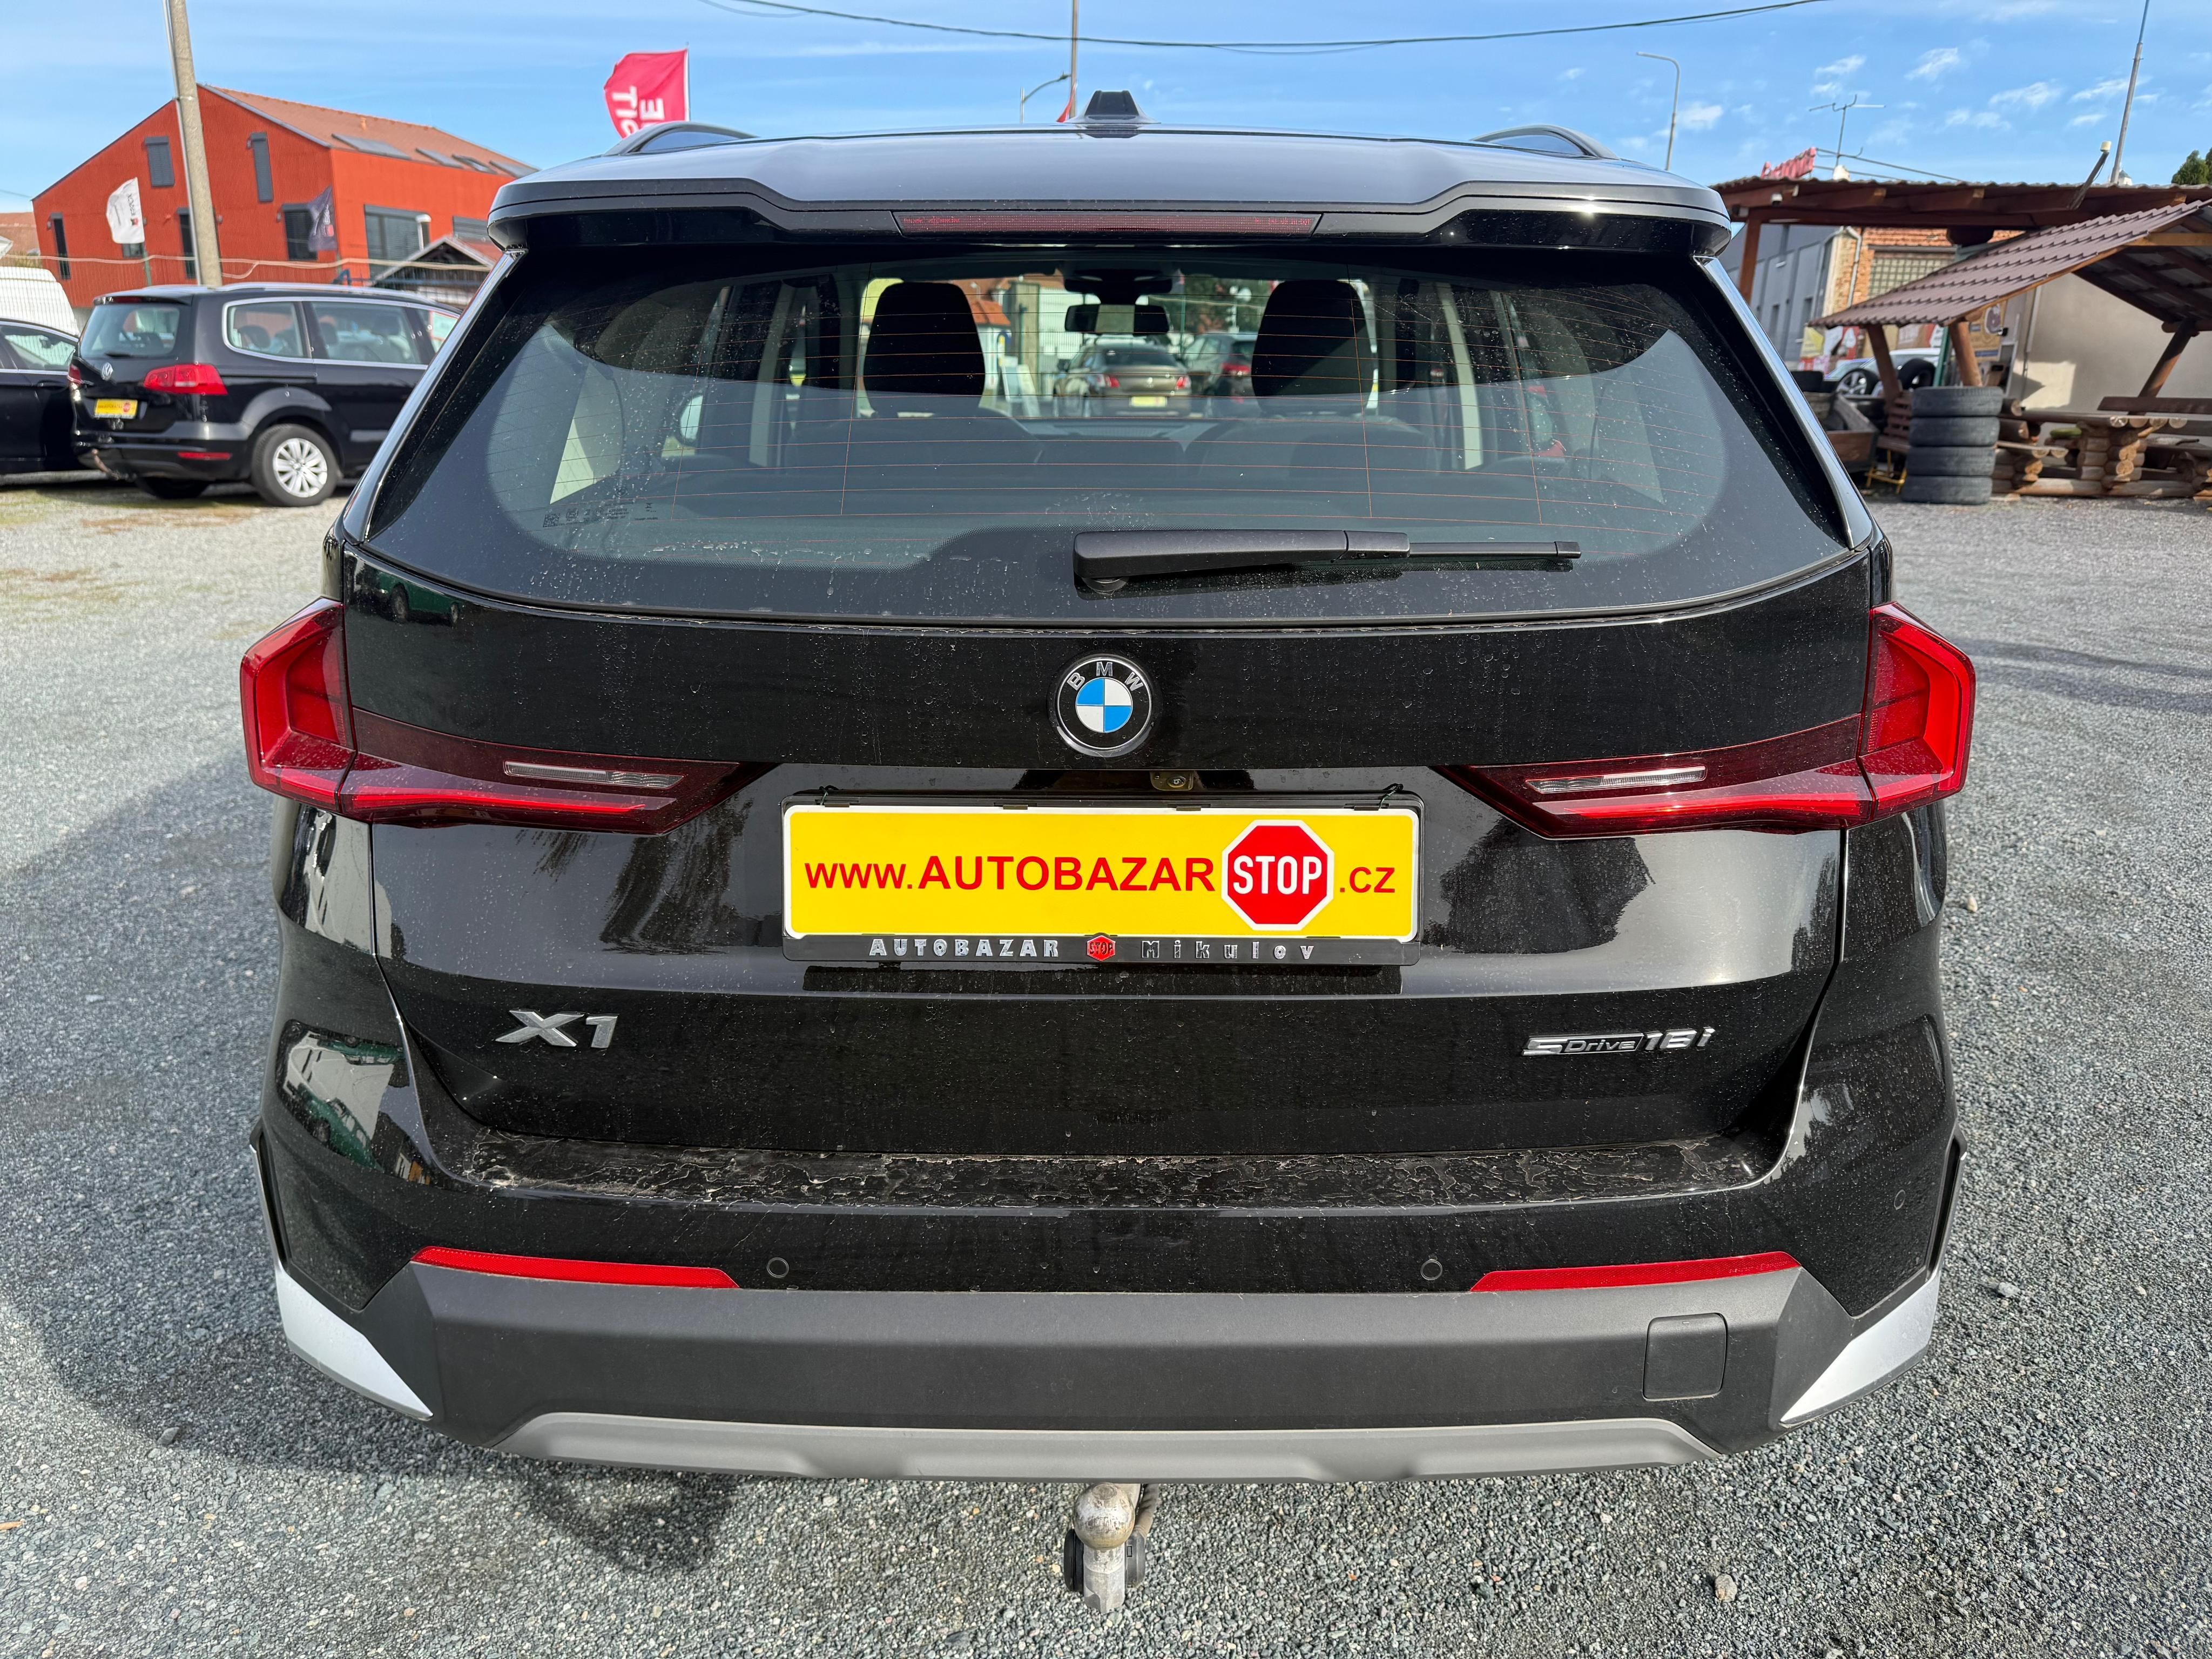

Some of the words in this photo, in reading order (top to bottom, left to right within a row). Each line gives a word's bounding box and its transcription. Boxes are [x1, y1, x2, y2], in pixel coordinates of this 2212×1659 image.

[1067, 662, 1144, 691] BMW
[869, 938, 1060, 957] AUTOBAZAR
[1089, 941, 1114, 955] STOP
[1142, 940, 1314, 960] Mikulov
[495, 1010, 619, 1048] X1
